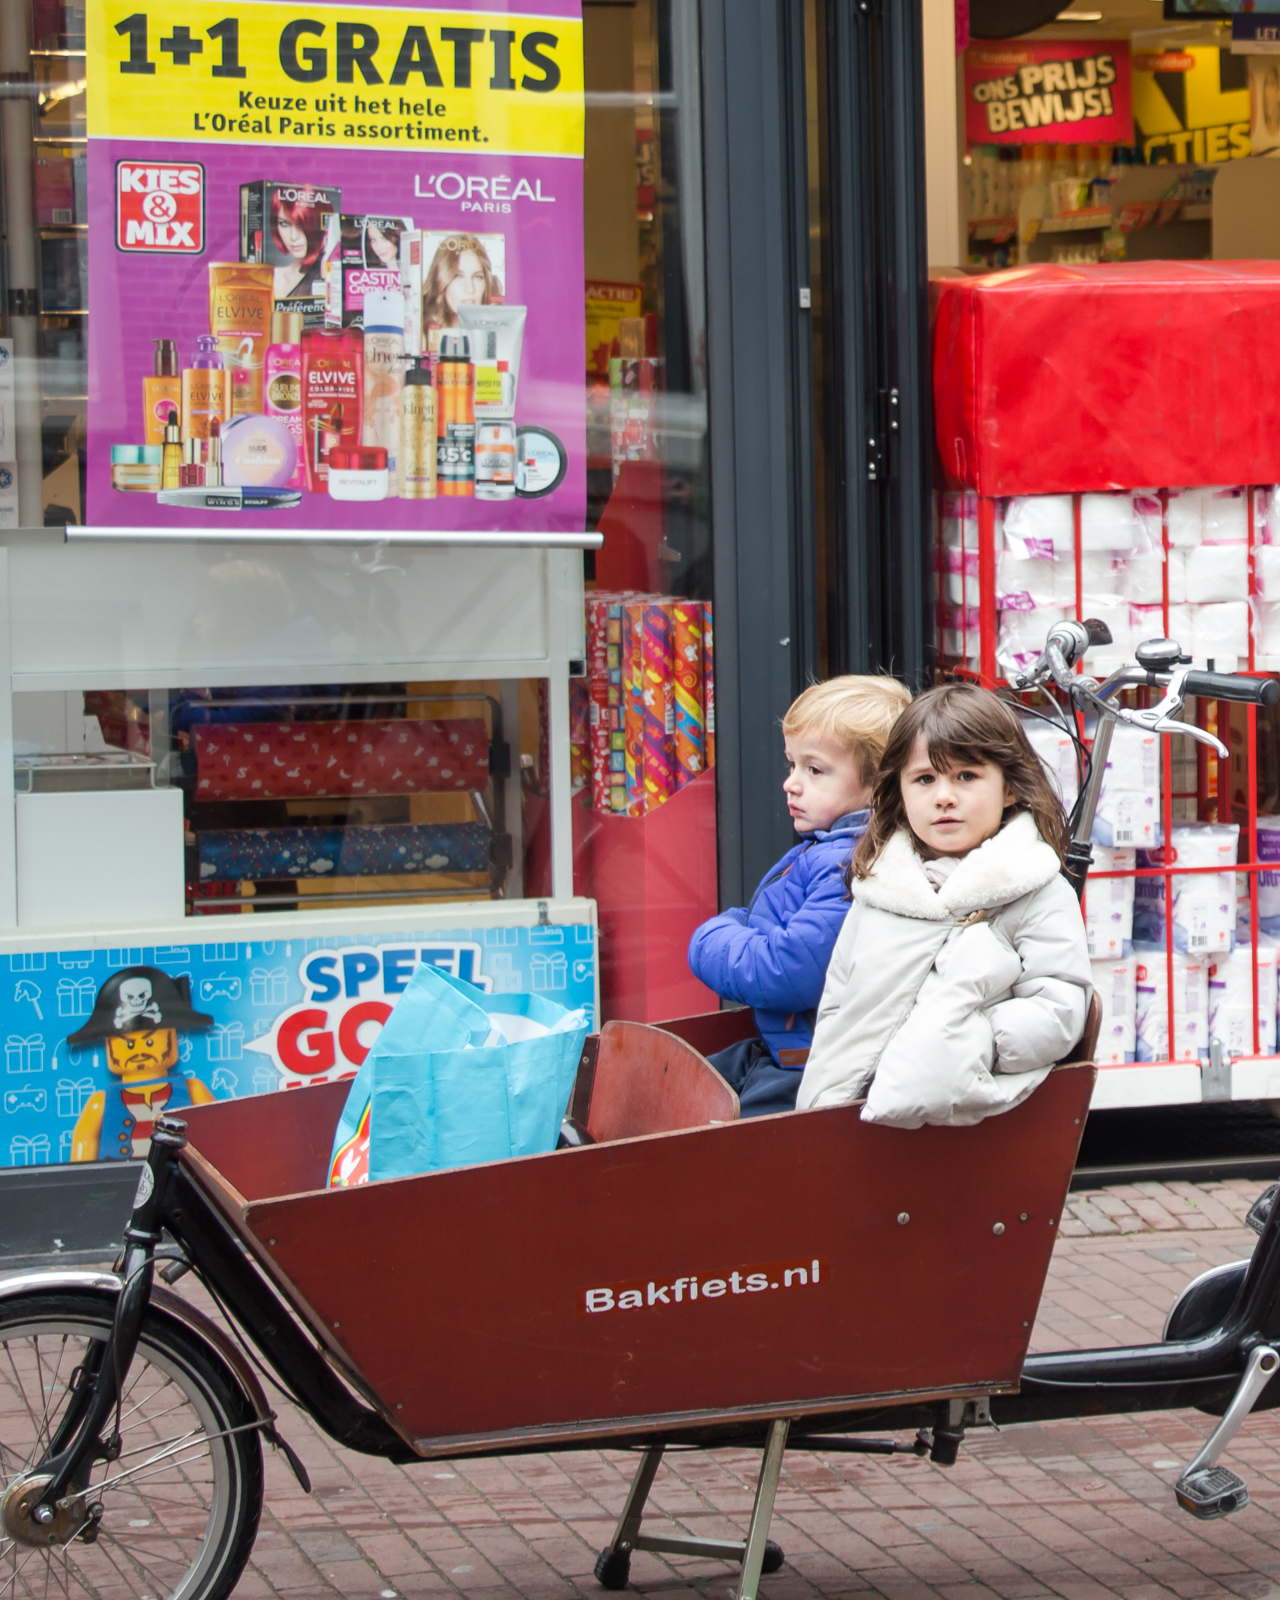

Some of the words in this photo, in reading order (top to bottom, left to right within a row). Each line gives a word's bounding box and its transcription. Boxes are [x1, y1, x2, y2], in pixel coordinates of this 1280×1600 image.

[1256, 28, 1278, 40] LET
[113, 12, 247, 79] 1+1
[278, 18, 562, 93] GRATIS
[974, 76, 1019, 102] ONS
[1019, 54, 1116, 95] PRIJS
[238, 90, 308, 113] Keuze
[314, 93, 348, 114] uit
[354, 95, 392, 115] het
[399, 98, 447, 117] hele
[987, 87, 1114, 133] BEWIJS!
[193, 112, 273, 135] L'Oréal
[278, 118, 337, 138] Paris
[343, 121, 490, 144] assortiment.
[120, 168, 200, 195] KIES
[414, 171, 556, 203] L'ORÉAL
[150, 194, 172, 219] &
[461, 200, 512, 214] PARIS
[124, 220, 197, 248] MIX
[349, 272, 401, 285] CASTIN
[217, 306, 264, 319] ELVIVE
[309, 371, 355, 384] ELVIVE
[190, 392, 224, 401] ELVIVE
[585, 1259, 820, 1313] Bakfiets.nl
